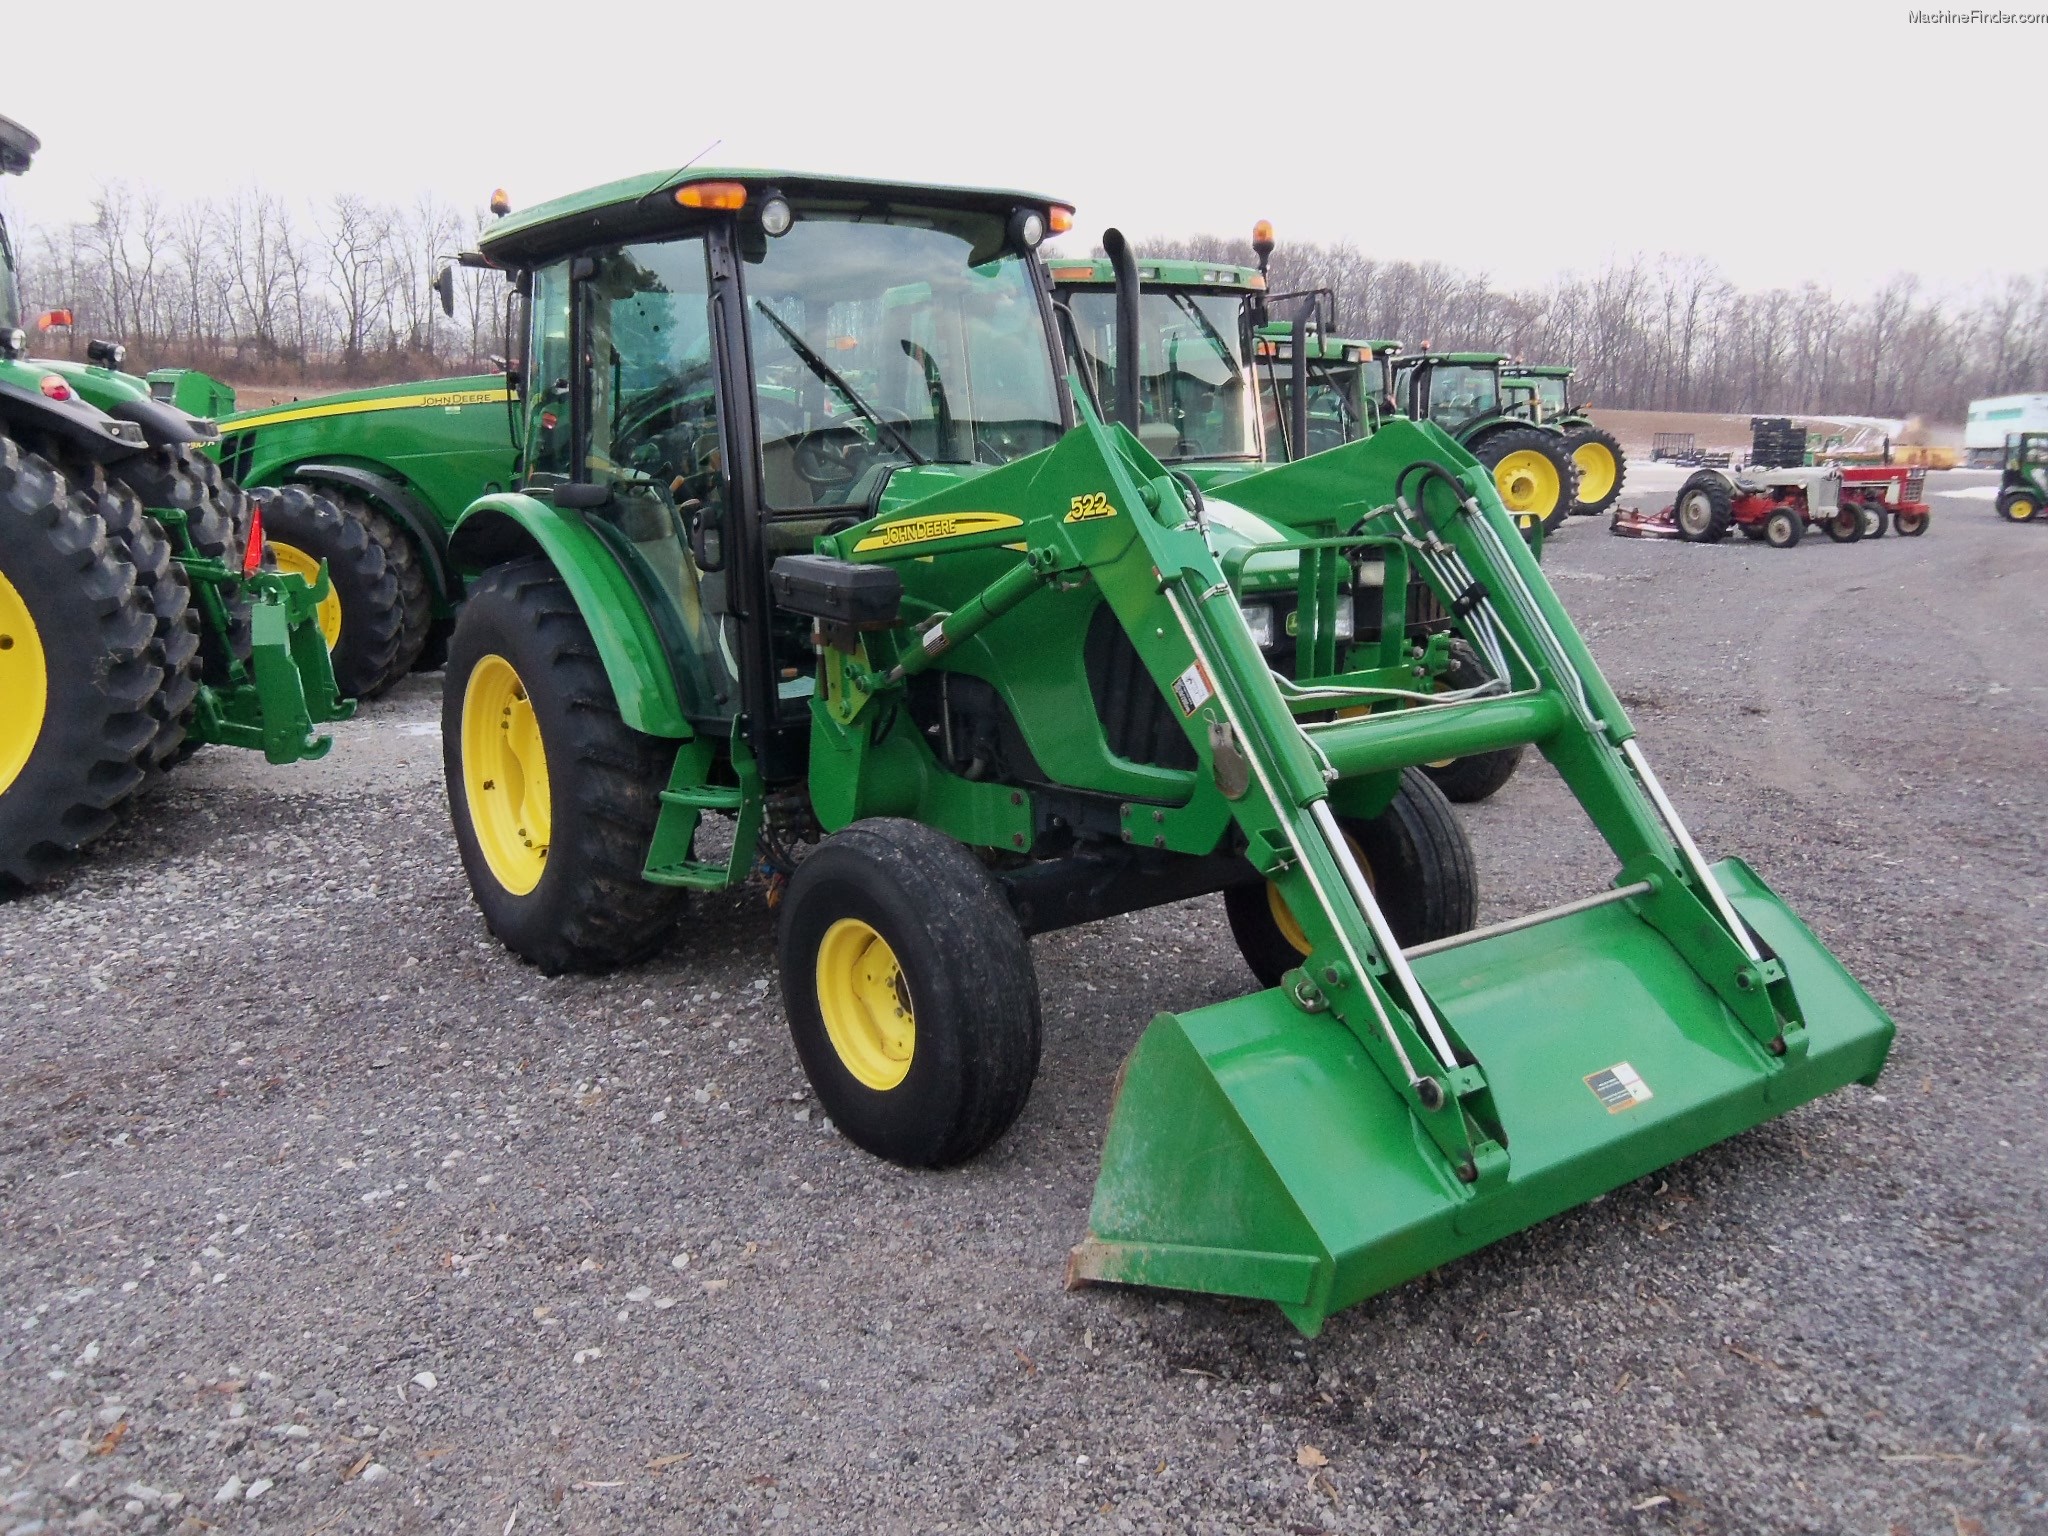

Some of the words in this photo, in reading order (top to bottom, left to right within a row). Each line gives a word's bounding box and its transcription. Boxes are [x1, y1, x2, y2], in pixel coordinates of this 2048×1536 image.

[421, 396, 451, 406] JOHN
[452, 394, 491, 404] DEERE
[1071, 491, 1108, 519] 522
[883, 525, 916, 545] JOHN
[916, 519, 957, 540] DEERE
